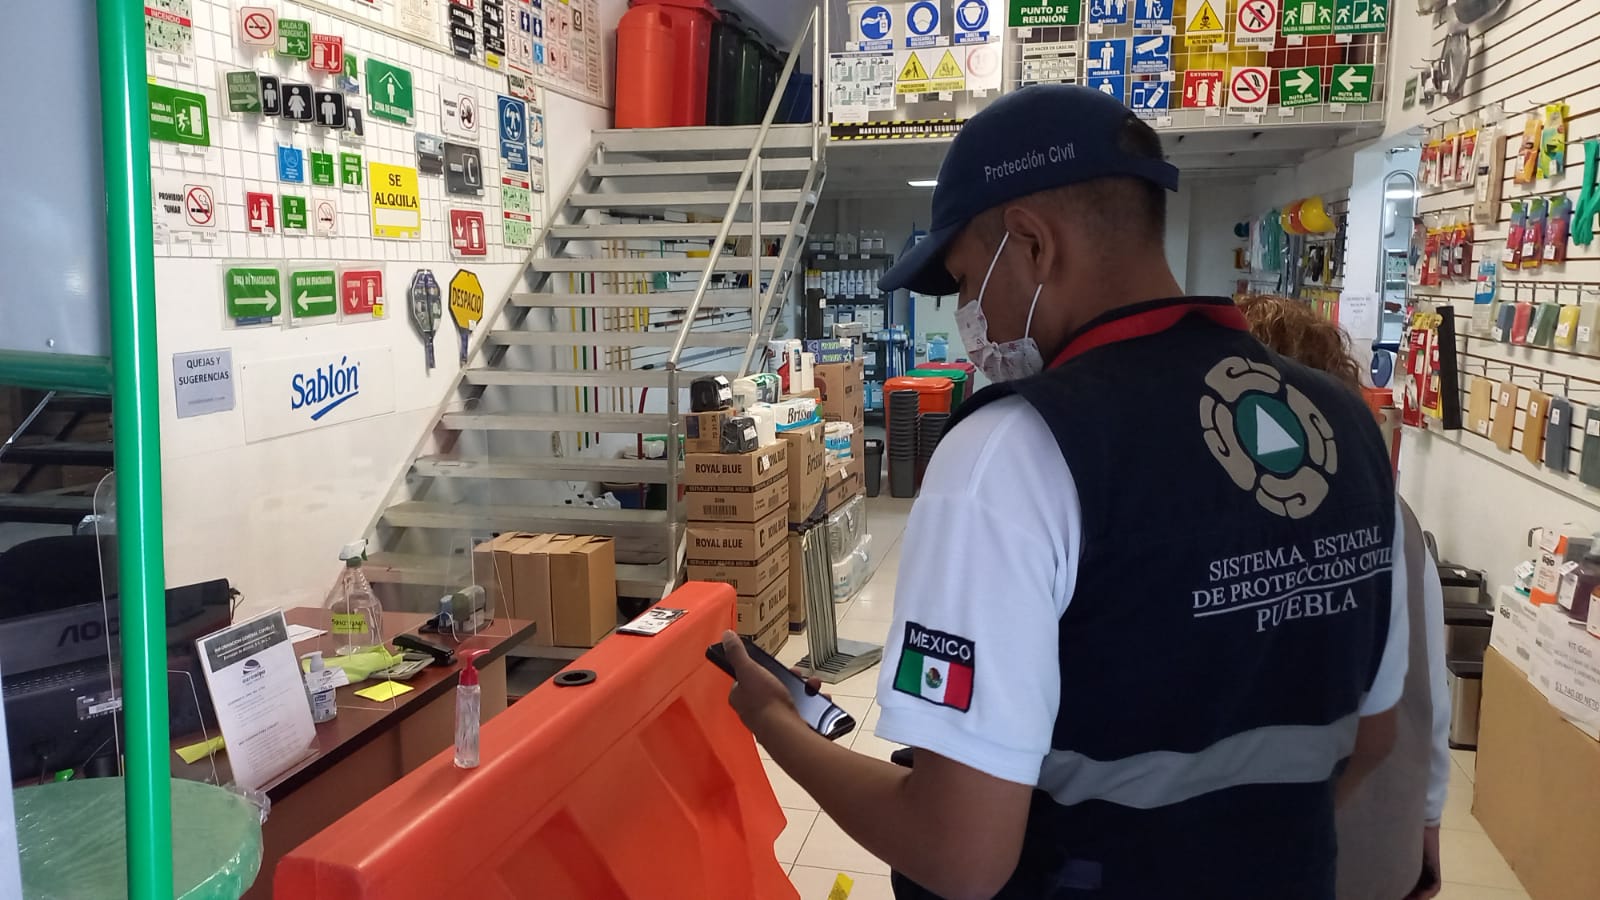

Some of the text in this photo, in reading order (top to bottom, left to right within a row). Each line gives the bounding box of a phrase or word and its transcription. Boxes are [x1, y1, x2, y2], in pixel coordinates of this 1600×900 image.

[1021, 5, 1069, 15] PUNTO DE
[1022, 13, 1067, 24] REUNIÓN
[891, 125, 925, 134] DISTANCIA
[925, 125, 933, 133] DE
[984, 143, 1075, 182] Protección Civil
[388, 174, 402, 187] SE
[158, 192, 184, 202] PROHIBIDO
[374, 194, 418, 209] ALQUILA
[452, 287, 481, 314] DESPACIO
[186, 356, 221, 369] QUEJAS Y
[178, 371, 229, 385] SUGERENCIAS
[291, 355, 359, 410] Sablón
[695, 463, 743, 474] ROYAL BLUE
[695, 538, 743, 548] ROYAL BLUE
[1208, 524, 1382, 582] SISTEMA ESTATAL
[1192, 546, 1392, 609] DE PROTECCIÓN CIVIL
[1256, 588, 1358, 632] PUEBLA
[909, 628, 971, 660] MEXICO
